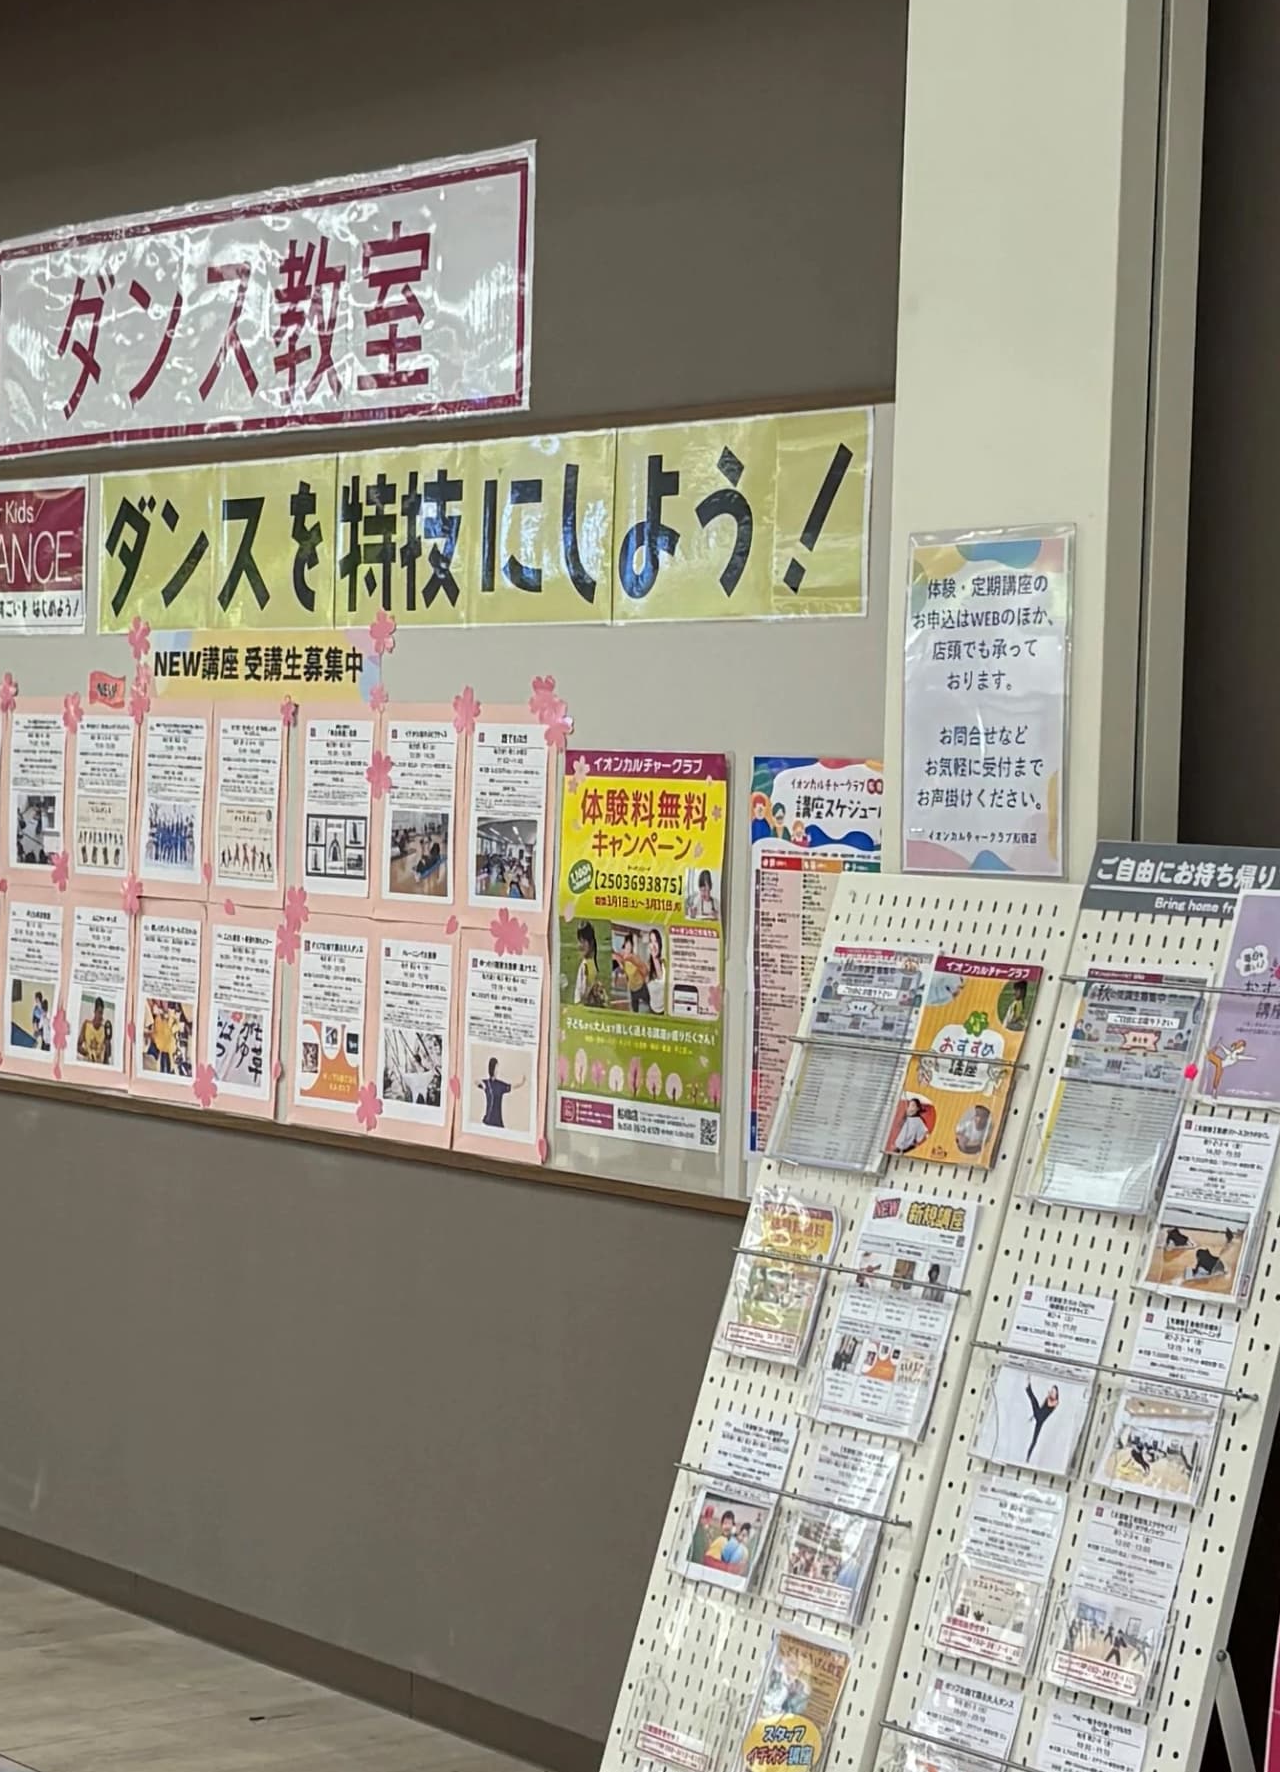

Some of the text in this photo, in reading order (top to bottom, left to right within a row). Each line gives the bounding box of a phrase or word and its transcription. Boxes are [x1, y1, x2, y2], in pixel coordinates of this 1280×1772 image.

[57, 220, 433, 422] ダンス教室
[6, 498, 35, 525] Kids
[927, 574, 1048, 599] 体験・定期講座の
[912, 606, 1055, 630] お申込はWEBのほか、
[932, 639, 1038, 661] 店頭でも承って
[154, 646, 364, 683] NEW講座 受講生募集中
[947, 670, 1013, 692] おります。
[939, 726, 1029, 746] お問合せなど
[594, 757, 703, 775] イオンカルチャークラブ
[924, 756, 1044, 779] お気軽に受付まで
[581, 788, 708, 831] 体験料無料
[796, 795, 882, 820] 講座スケジュー
[916, 788, 1043, 811] お声掛けください。
[592, 829, 692, 861] キャンペーン
[1154, 897, 1186, 912] Bring
[1188, 900, 1219, 913] home
[946, 961, 1030, 978] イオンカルチャークラブ
[873, 1198, 901, 1219] NEW
[906, 1201, 966, 1233] 新規講座
[762, 1725, 807, 1743] スタッフ
[746, 1744, 814, 1766] イチオシ講座
